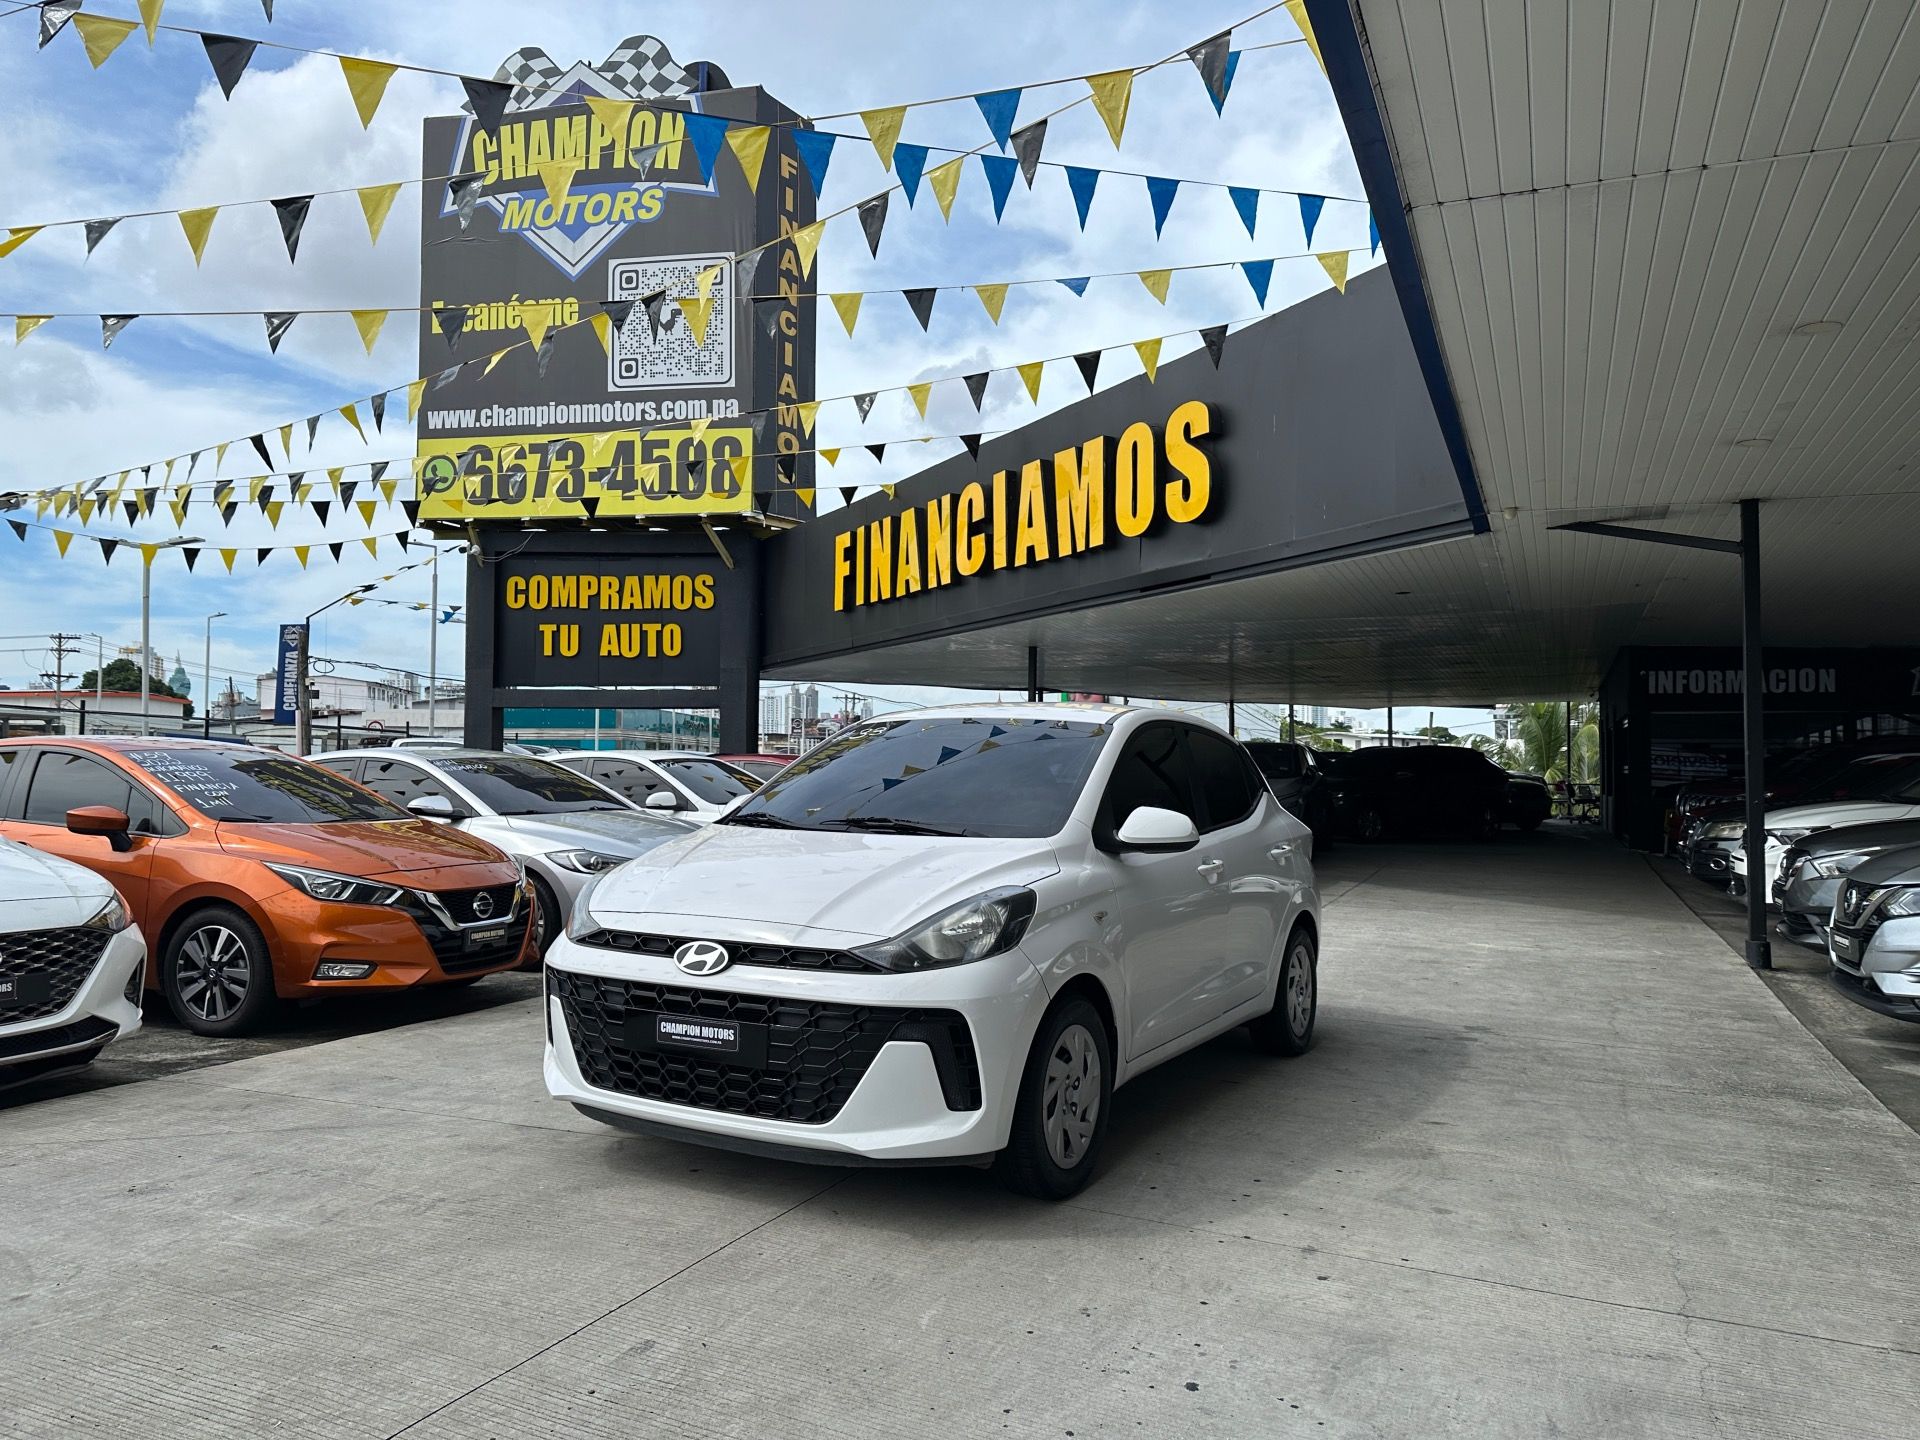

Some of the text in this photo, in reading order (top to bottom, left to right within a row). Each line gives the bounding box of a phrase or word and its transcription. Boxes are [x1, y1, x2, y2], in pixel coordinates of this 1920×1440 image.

[501, 188, 664, 231] MOTORS
[427, 398, 739, 429] www.championmotors.com.pa
[834, 400, 1212, 612] FINANCIAMOS
[506, 574, 715, 610] COMPRAMOS
[539, 623, 682, 657] TU AUTO
[282, 650, 299, 711] CONFIANZA
[660, 1021, 700, 1037] CHAMPION
[701, 1026, 735, 1041] MOTORS
